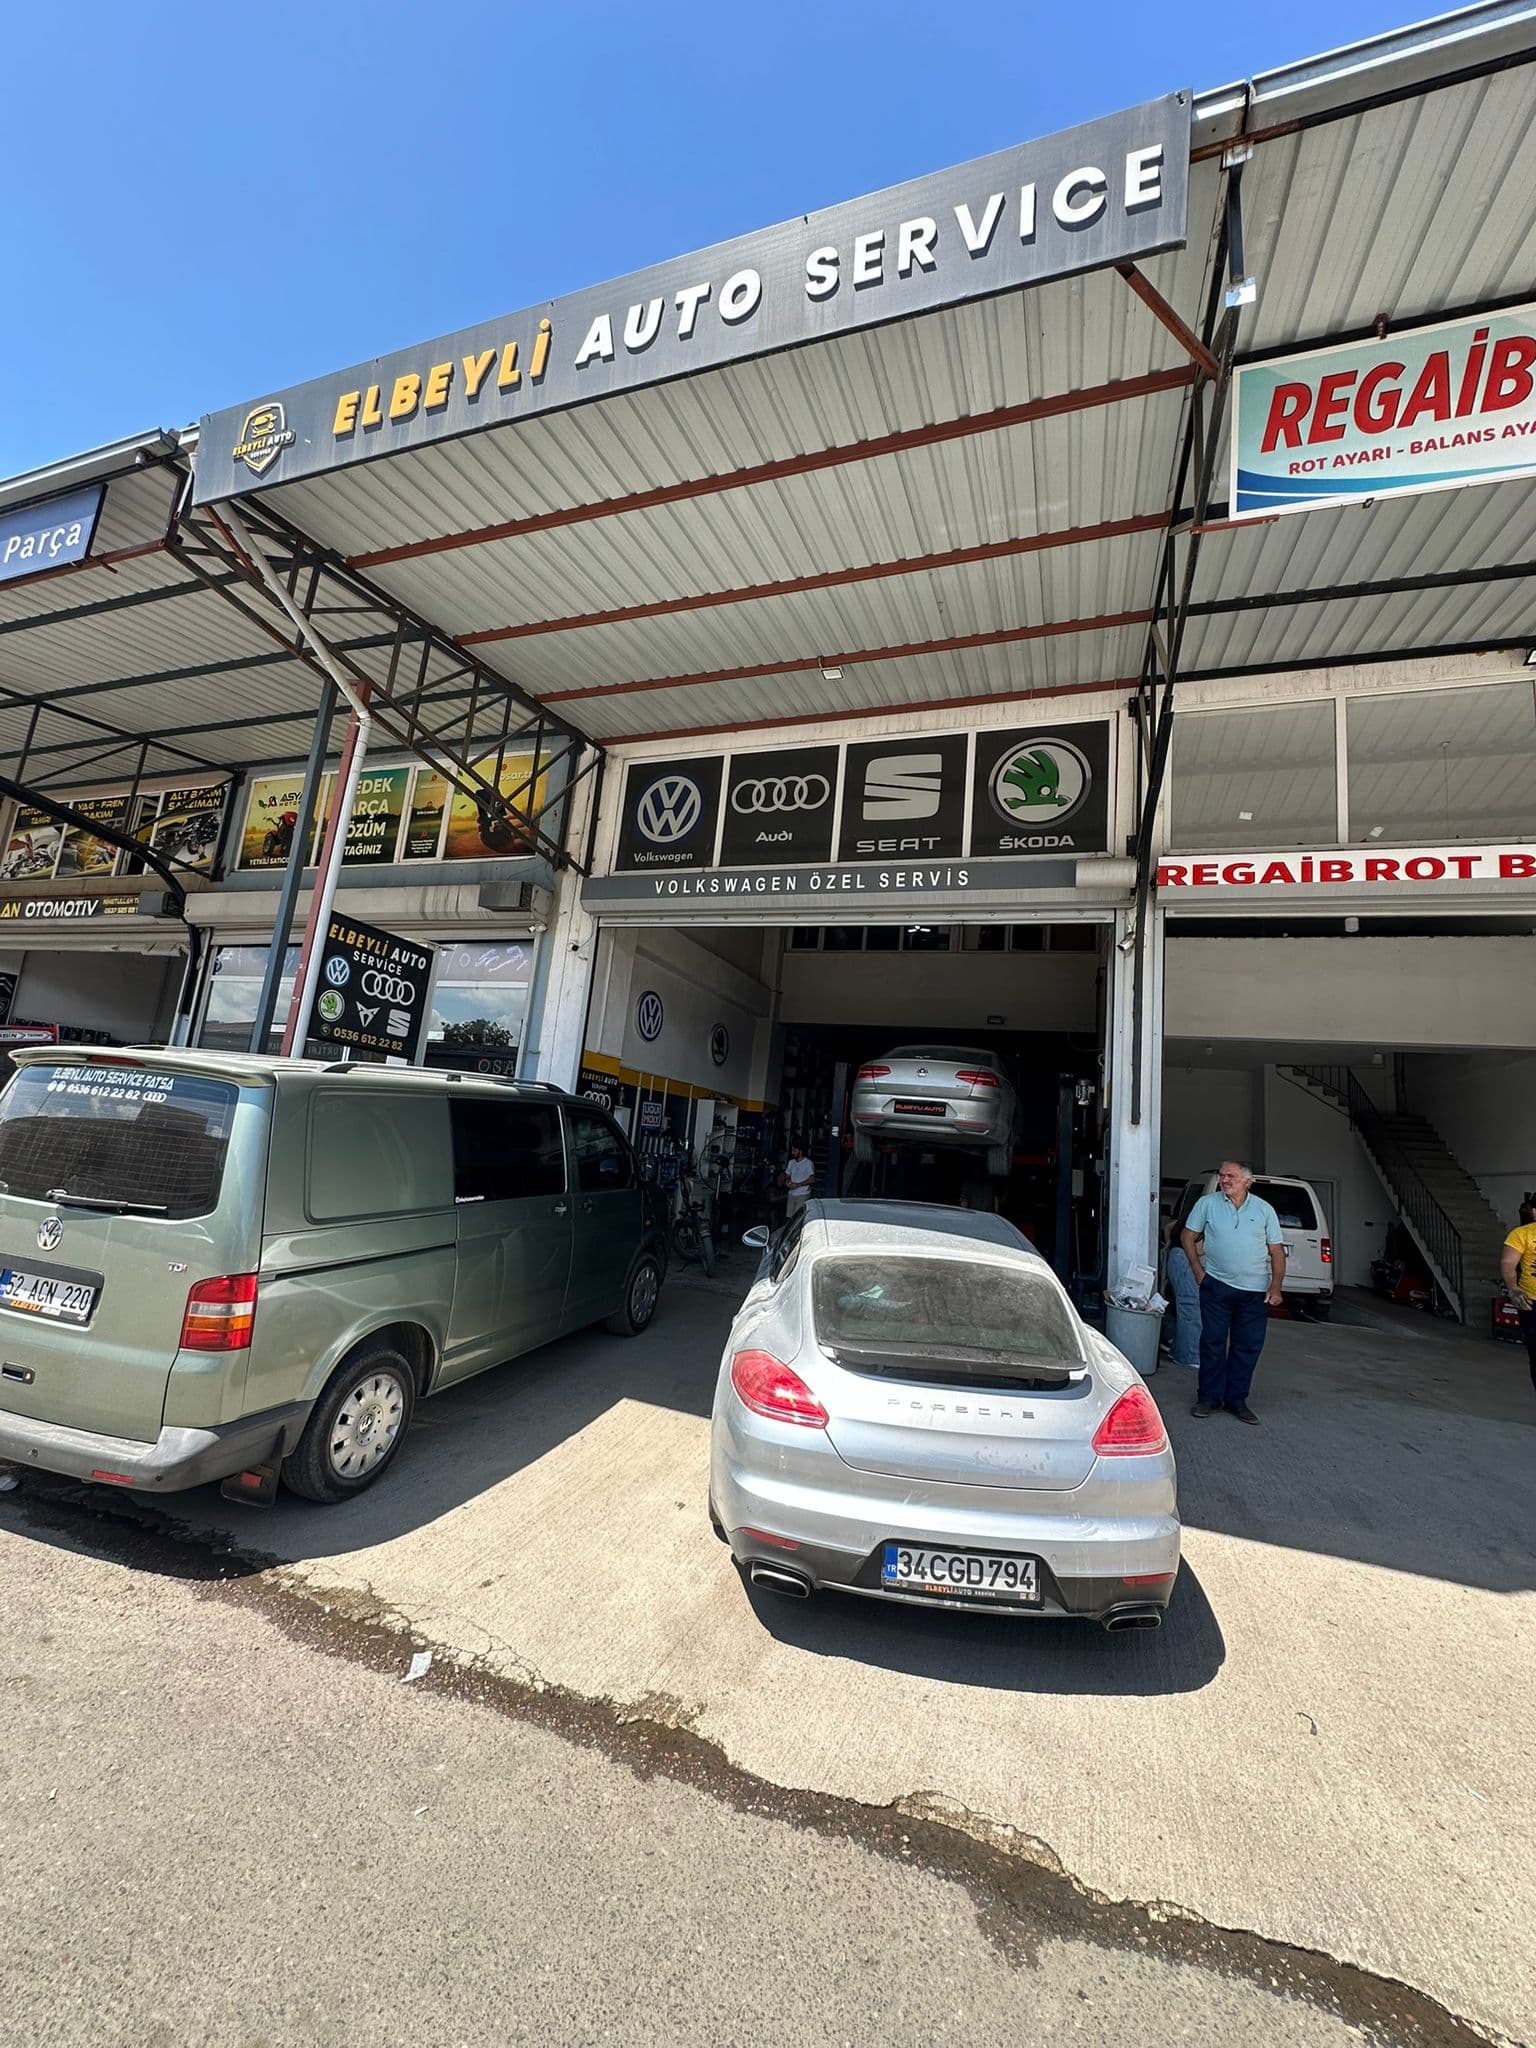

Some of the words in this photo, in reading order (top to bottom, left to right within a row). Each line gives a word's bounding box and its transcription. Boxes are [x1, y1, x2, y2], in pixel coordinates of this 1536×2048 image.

[333, 319, 551, 436] ELBEYLİ
[574, 269, 762, 369] AUTO
[805, 144, 1164, 298] SERVICE
[1261, 327, 1536, 453] REGAİB
[267, 431, 292, 446] AUTO
[1288, 457, 1327, 475] ROT
[1332, 446, 1391, 469] AYARI
[1410, 428, 1495, 454] BALANS
[3, 523, 81, 563] Parça
[101, 799, 124, 808] FREN
[170, 791, 189, 801] ALT
[347, 820, 386, 838] ÖZÜM
[755, 831, 793, 843] Audi
[344, 843, 382, 856] TAĞINIZ
[856, 837, 941, 853] SEAT
[999, 834, 1075, 849] ŠKODA
[634, 851, 693, 864] Volkswagen
[1157, 855, 1354, 887] REGAİB
[1365, 854, 1482, 882] ROT
[655, 876, 798, 895] VOLKSWAGEN
[809, 871, 866, 891] ÖZEL
[879, 867, 970, 888] SERVİS
[25, 899, 99, 917] OTOMOTİV
[329, 923, 389, 956] ELBEYLİ
[391, 947, 426, 970] AUTO
[333, 1027, 359, 1041] 0536
[361, 1033, 377, 1046] 612
[378, 1038, 390, 1047] 22
[391, 1040, 403, 1051] 82
[52, 1066, 87, 1081] ELBEYLİ
[82, 1069, 106, 1082] AUTO
[142, 1076, 174, 1090] FATSA
[67, 1083, 90, 1095] 0536
[91, 1086, 110, 1097] 612
[110, 1088, 126, 1098] 22
[125, 1089, 140, 1100] 82
[924, 1105, 945, 1113] AUTO
[5, 1273, 24, 1297] 52
[28, 1279, 59, 1305] ACN
[60, 1285, 91, 1311] 220
[887, 1398, 1035, 1420] PORSCHE
[887, 1564, 897, 1573] TR
[953, 1587, 972, 1596] AUTO
